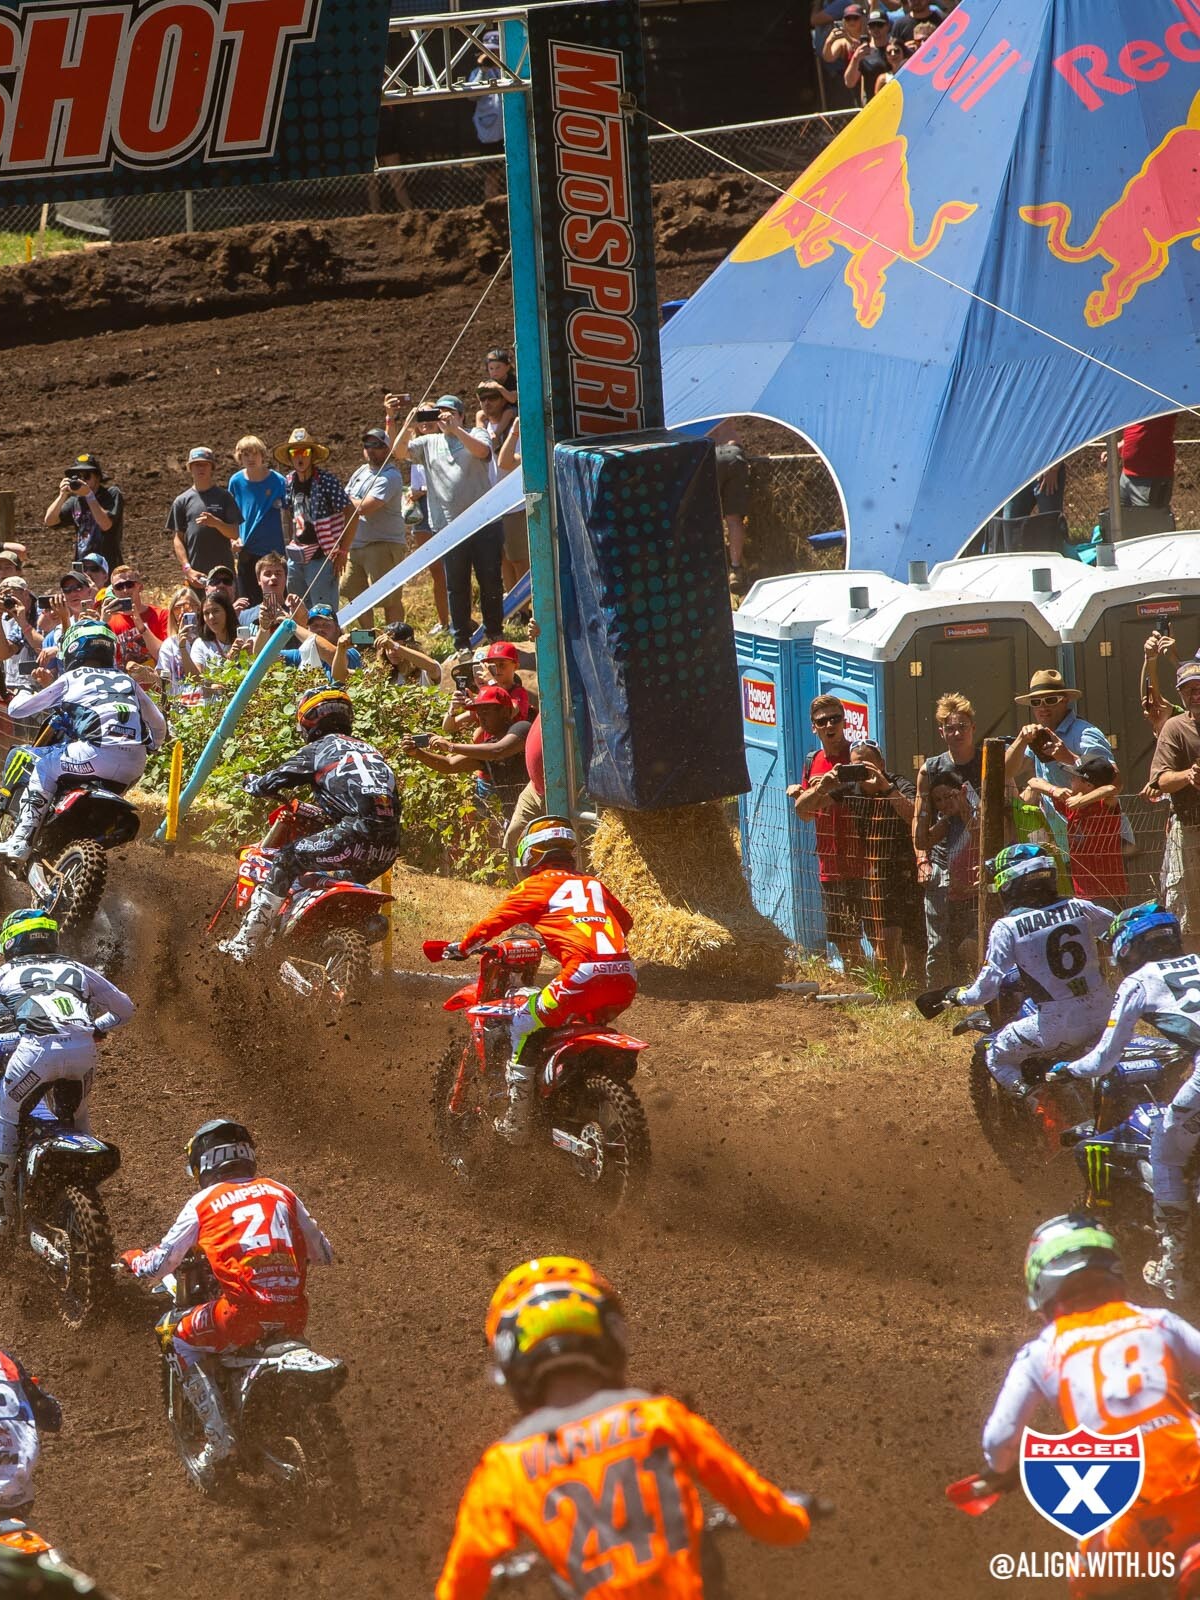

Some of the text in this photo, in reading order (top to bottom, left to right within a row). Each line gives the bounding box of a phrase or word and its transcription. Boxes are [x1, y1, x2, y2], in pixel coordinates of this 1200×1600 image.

[905, 9, 1021, 112] Bull
[747, 681, 772, 709] Honey
[749, 703, 776, 723] Bucket
[843, 708, 865, 728] oney
[843, 724, 868, 741] ucket
[548, 879, 606, 914] 41
[1015, 900, 1085, 938] MARTIN
[591, 963, 631, 975] ASTARS
[1046, 924, 1087, 979] 6
[231, 1199, 294, 1251] 24
[1061, 1328, 1167, 1432] 18
[544, 1446, 690, 1598] 241
